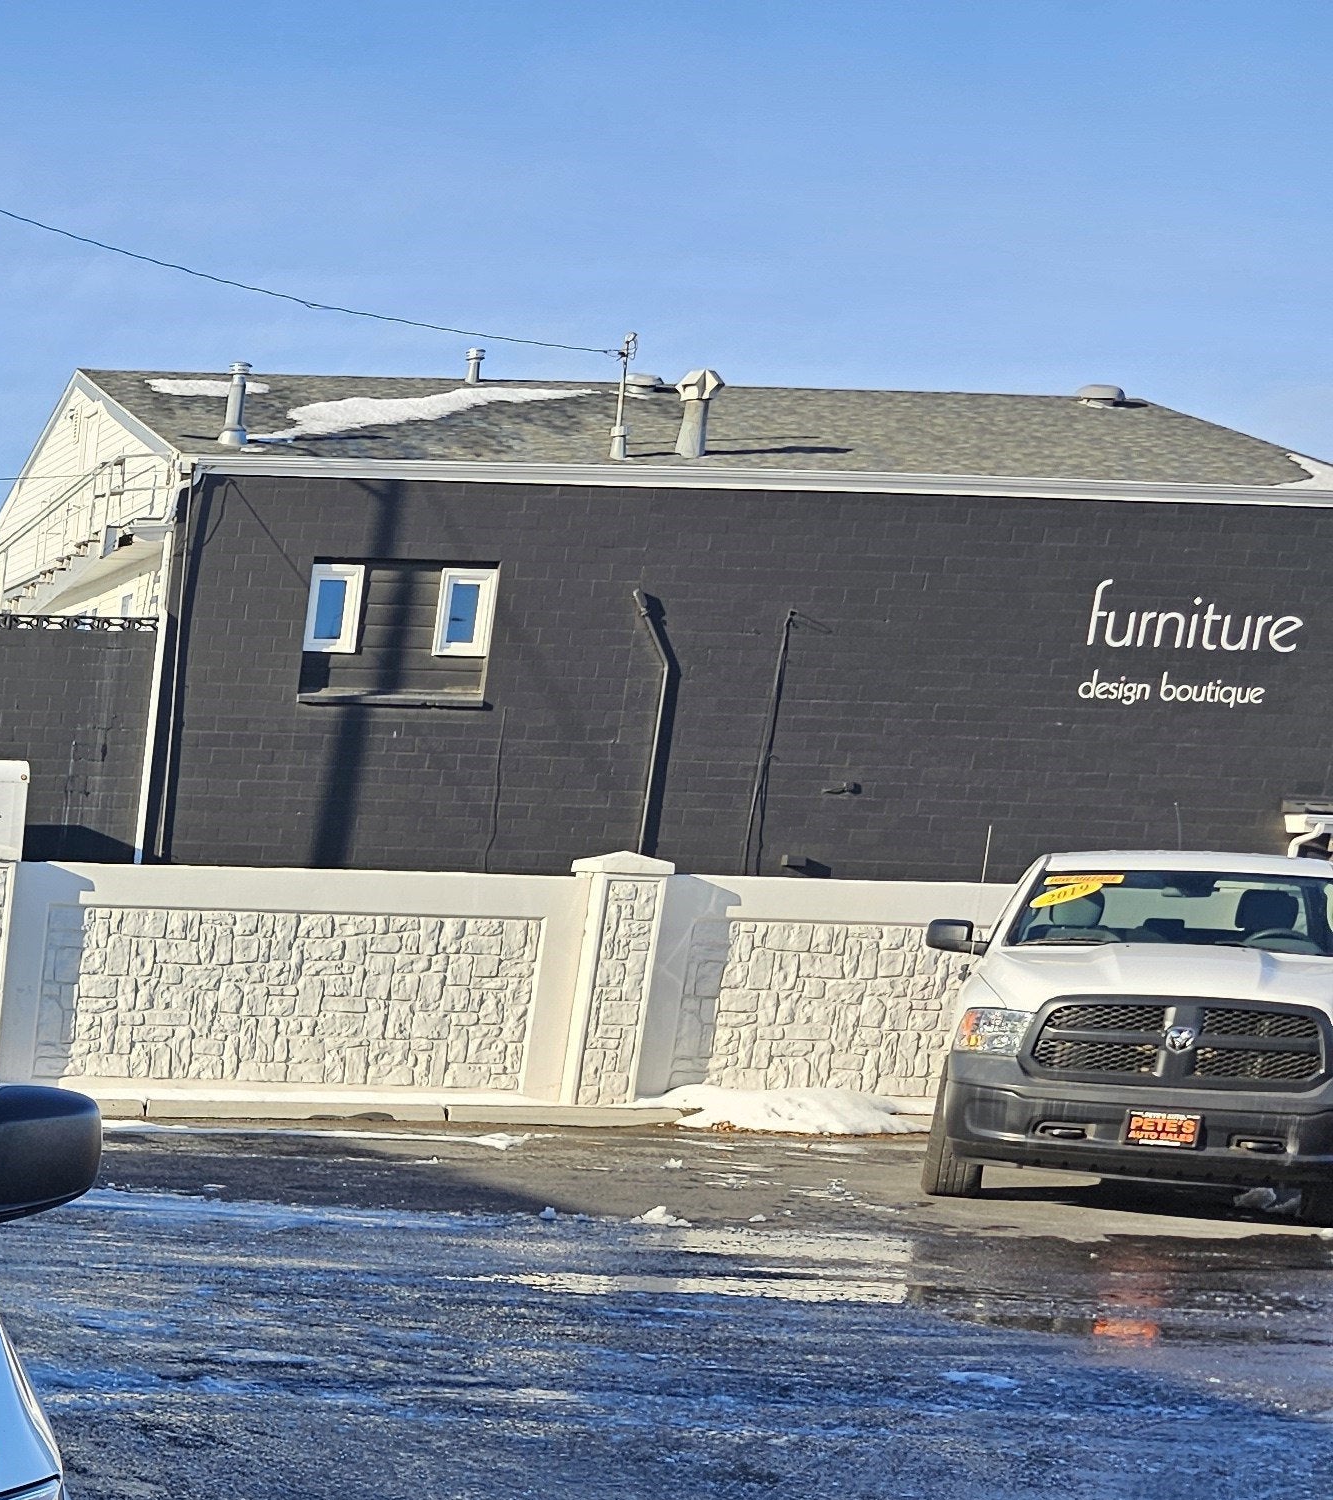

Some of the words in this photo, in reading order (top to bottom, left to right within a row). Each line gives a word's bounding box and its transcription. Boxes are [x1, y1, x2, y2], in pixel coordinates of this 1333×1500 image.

[1086, 578, 1304, 653] furniture
[1077, 668, 1151, 706] design
[1159, 671, 1266, 709] boutique
[1045, 884, 1090, 903] 2019
[1130, 1117, 1196, 1134] PETE'S
